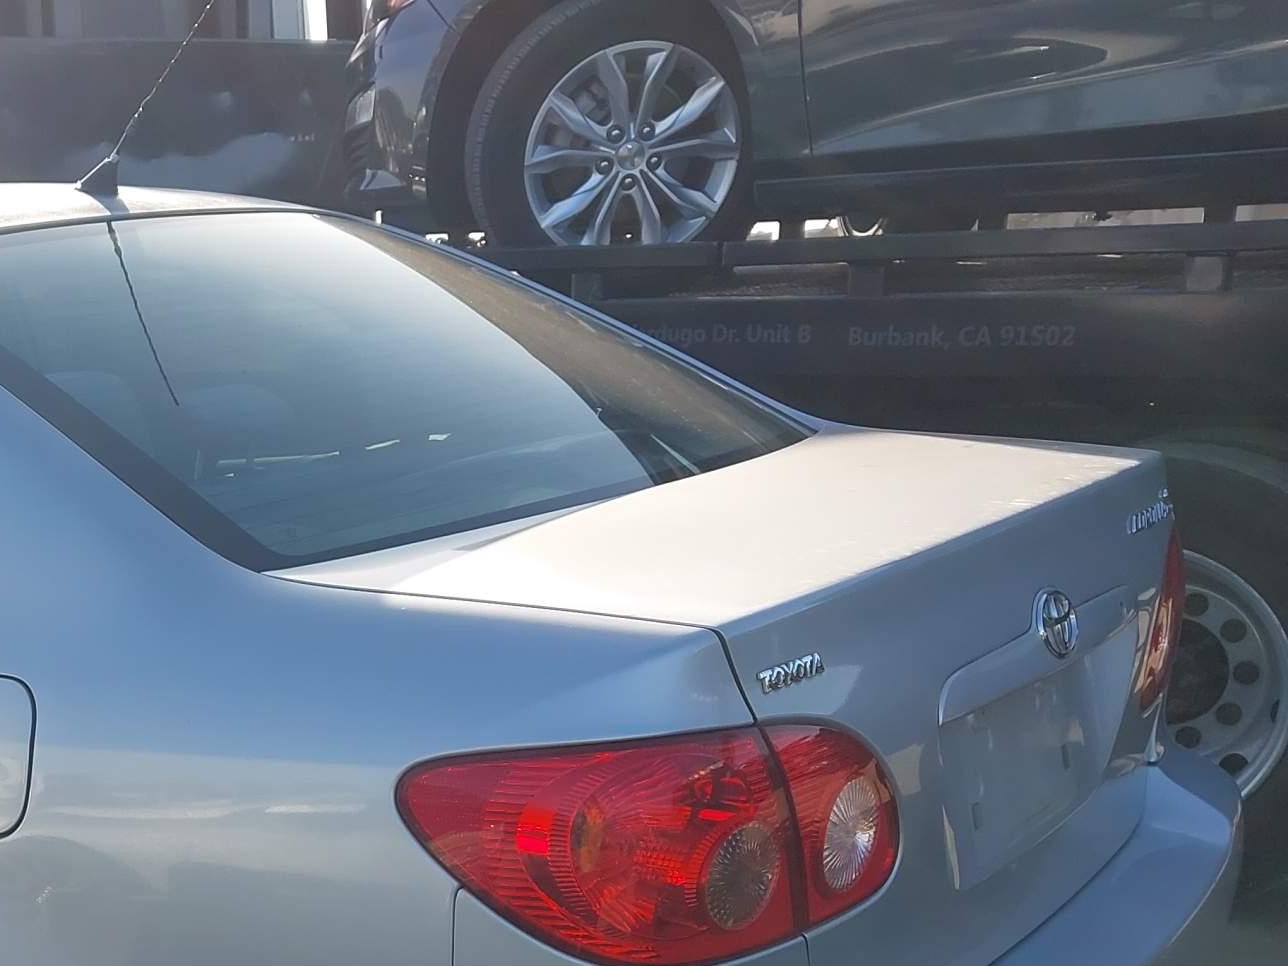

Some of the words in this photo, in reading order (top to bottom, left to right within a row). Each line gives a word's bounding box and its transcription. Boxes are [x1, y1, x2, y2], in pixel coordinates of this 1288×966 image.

[712, 323, 741, 344] Dr.
[746, 322, 792, 344] Unit
[797, 323, 813, 344] B
[848, 324, 954, 352] Burbank,
[959, 326, 993, 346] CA
[999, 325, 1077, 347] 91502
[757, 652, 825, 694] TOYOTA
